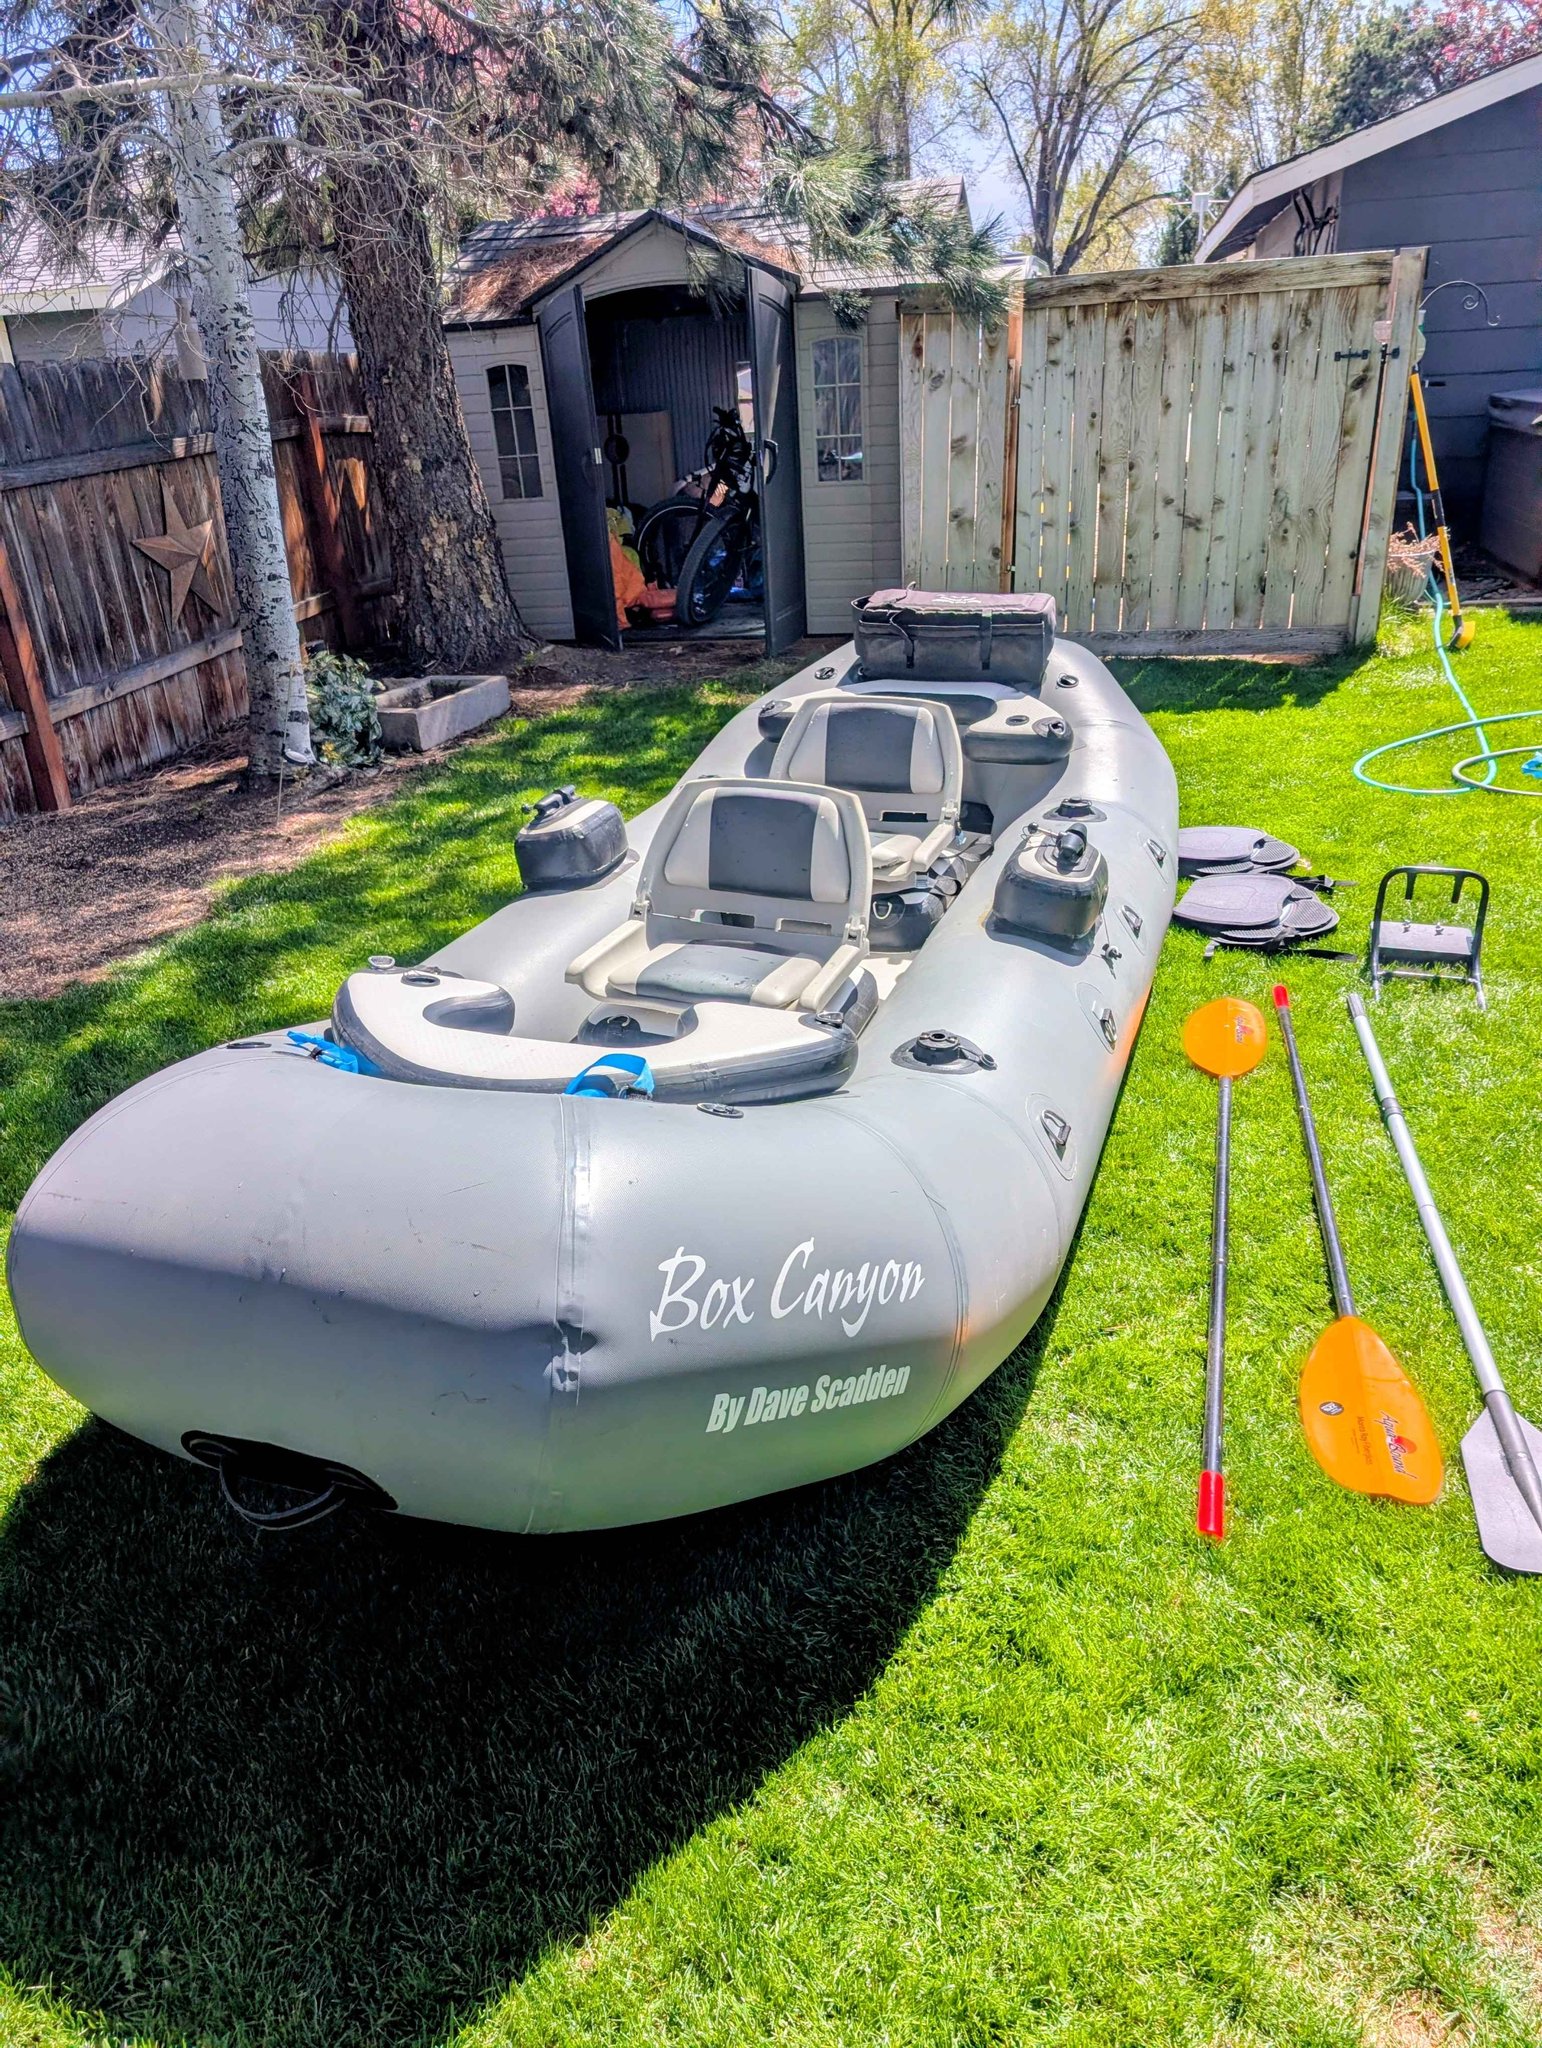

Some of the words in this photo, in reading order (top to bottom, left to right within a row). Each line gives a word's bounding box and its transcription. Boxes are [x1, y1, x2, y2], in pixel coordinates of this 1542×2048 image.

[650, 1246, 755, 1342] Box
[770, 1237, 926, 1338] Canyon
[705, 1393, 745, 1434] By
[743, 1383, 809, 1426] Dave
[810, 1364, 911, 1413] Scadden
